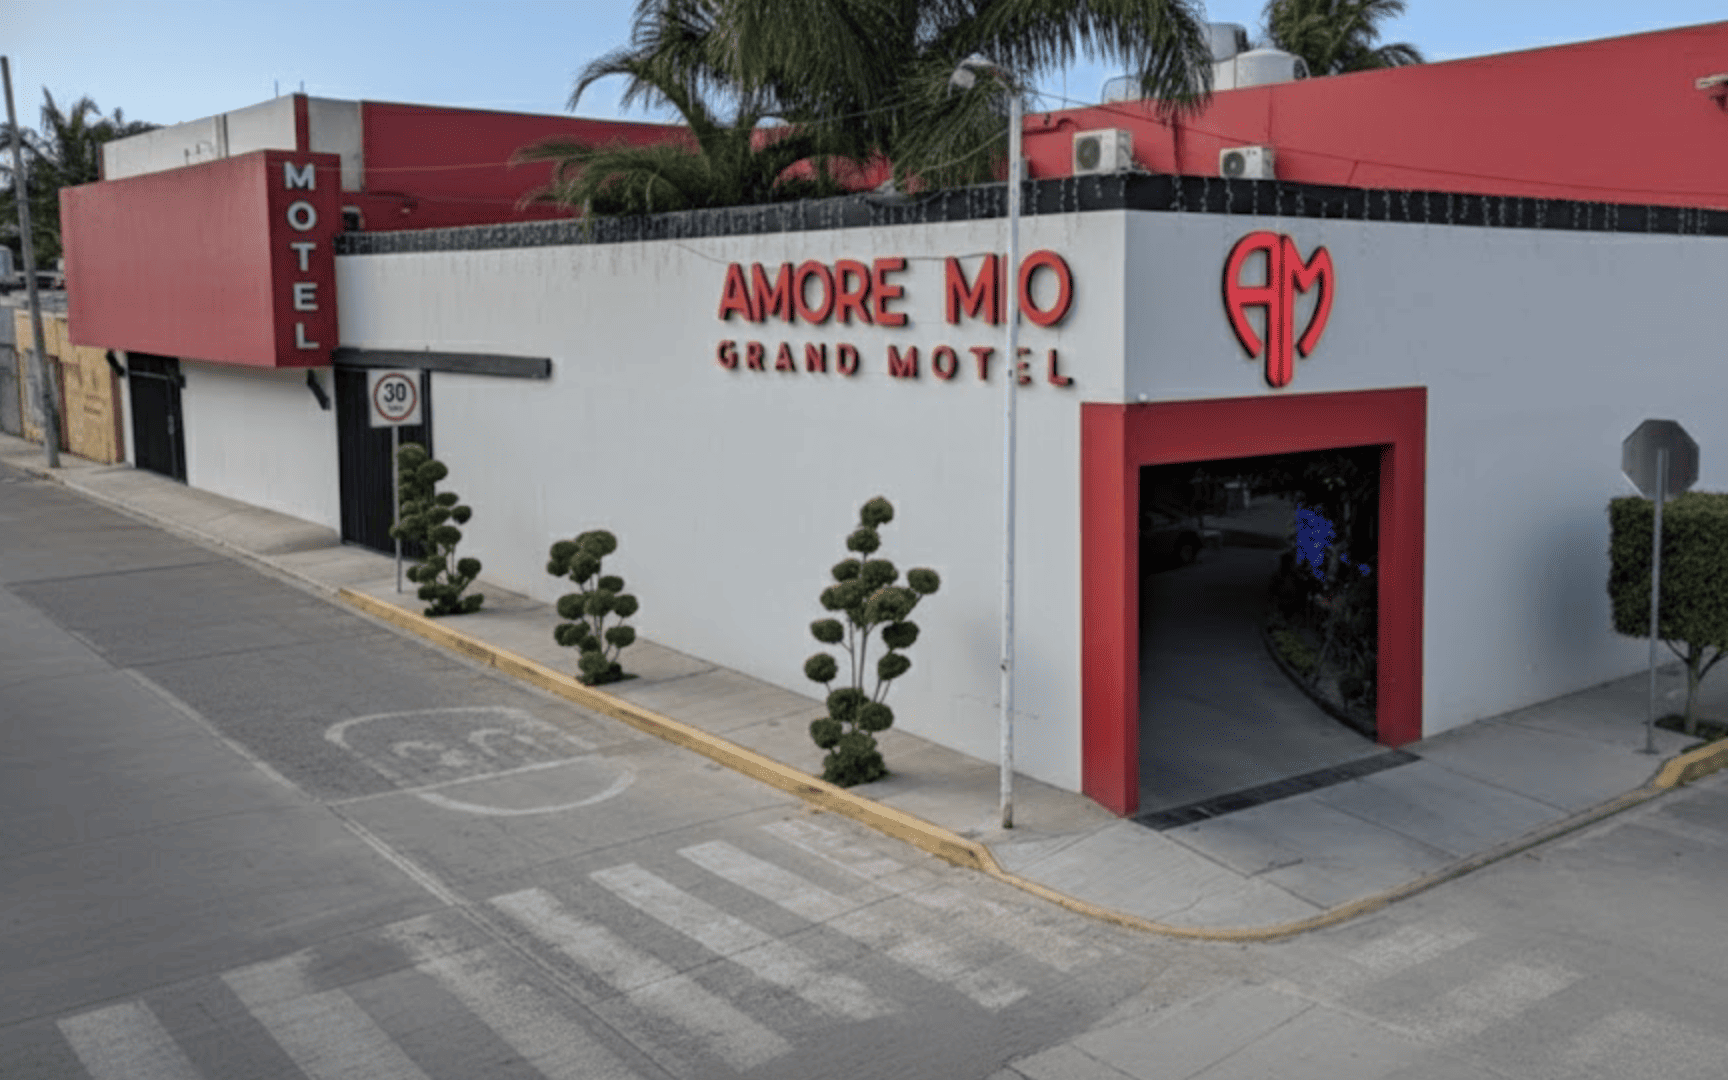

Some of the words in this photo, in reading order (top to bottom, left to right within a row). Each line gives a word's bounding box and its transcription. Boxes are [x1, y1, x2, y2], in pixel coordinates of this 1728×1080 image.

[285, 161, 320, 349] MOTEL
[718, 257, 908, 327] AMORE
[383, 382, 407, 403] 30
[717, 340, 860, 376] GRAND
[887, 344, 1074, 387] MOTEL
